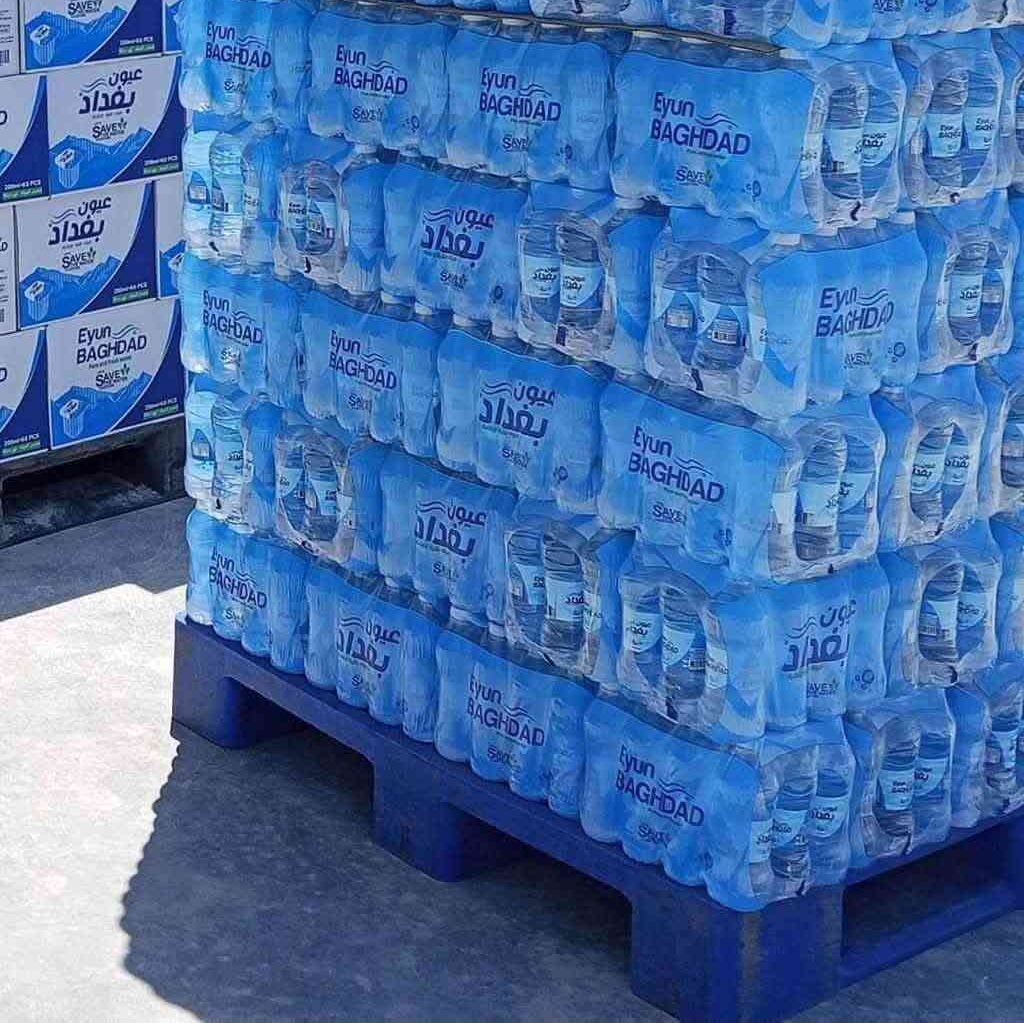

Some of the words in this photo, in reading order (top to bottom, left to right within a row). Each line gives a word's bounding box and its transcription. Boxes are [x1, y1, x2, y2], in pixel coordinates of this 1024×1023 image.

[207, 21, 235, 45] Eyun
[206, 43, 271, 69] BAGHDAD
[336, 44, 366, 68] Eyun
[108, 69, 143, 85] عيون
[335, 67, 407, 96] BAGHDAD
[481, 68, 516, 94] Eyun
[79, 85, 136, 114] بغداد
[480, 92, 561, 122] BAGHDAD
[654, 91, 694, 121] Eyun
[92, 123, 118, 138] SAVE
[650, 117, 750, 156] BAGHDAD
[78, 197, 112, 215] عيون
[48, 215, 105, 245] بغداد
[62, 252, 89, 269] SAVE
[420, 226, 483, 269] بغداد
[819, 287, 857, 310] Eyun
[202, 312, 263, 345] BAGHDAD
[815, 302, 894, 338] BAGHDAD
[76, 335, 147, 364] BAGHDAD
[78, 326, 111, 346] Eyun
[96, 371, 121, 387] SAVE
[329, 351, 397, 391] BAGHDAD
[512, 382, 555, 409] عيون
[479, 400, 548, 446] بغداد
[633, 426, 672, 457] Eyun
[628, 453, 724, 503] BAGHDAD
[447, 506, 486, 526] عيون
[414, 516, 475, 563] بغداد
[209, 566, 267, 609] BAGHDAD
[366, 622, 400, 645] عيون
[337, 629, 389, 678] بغداد
[466, 698, 545, 747] BAGHDAD
[616, 773, 704, 827] BAGHDAD
